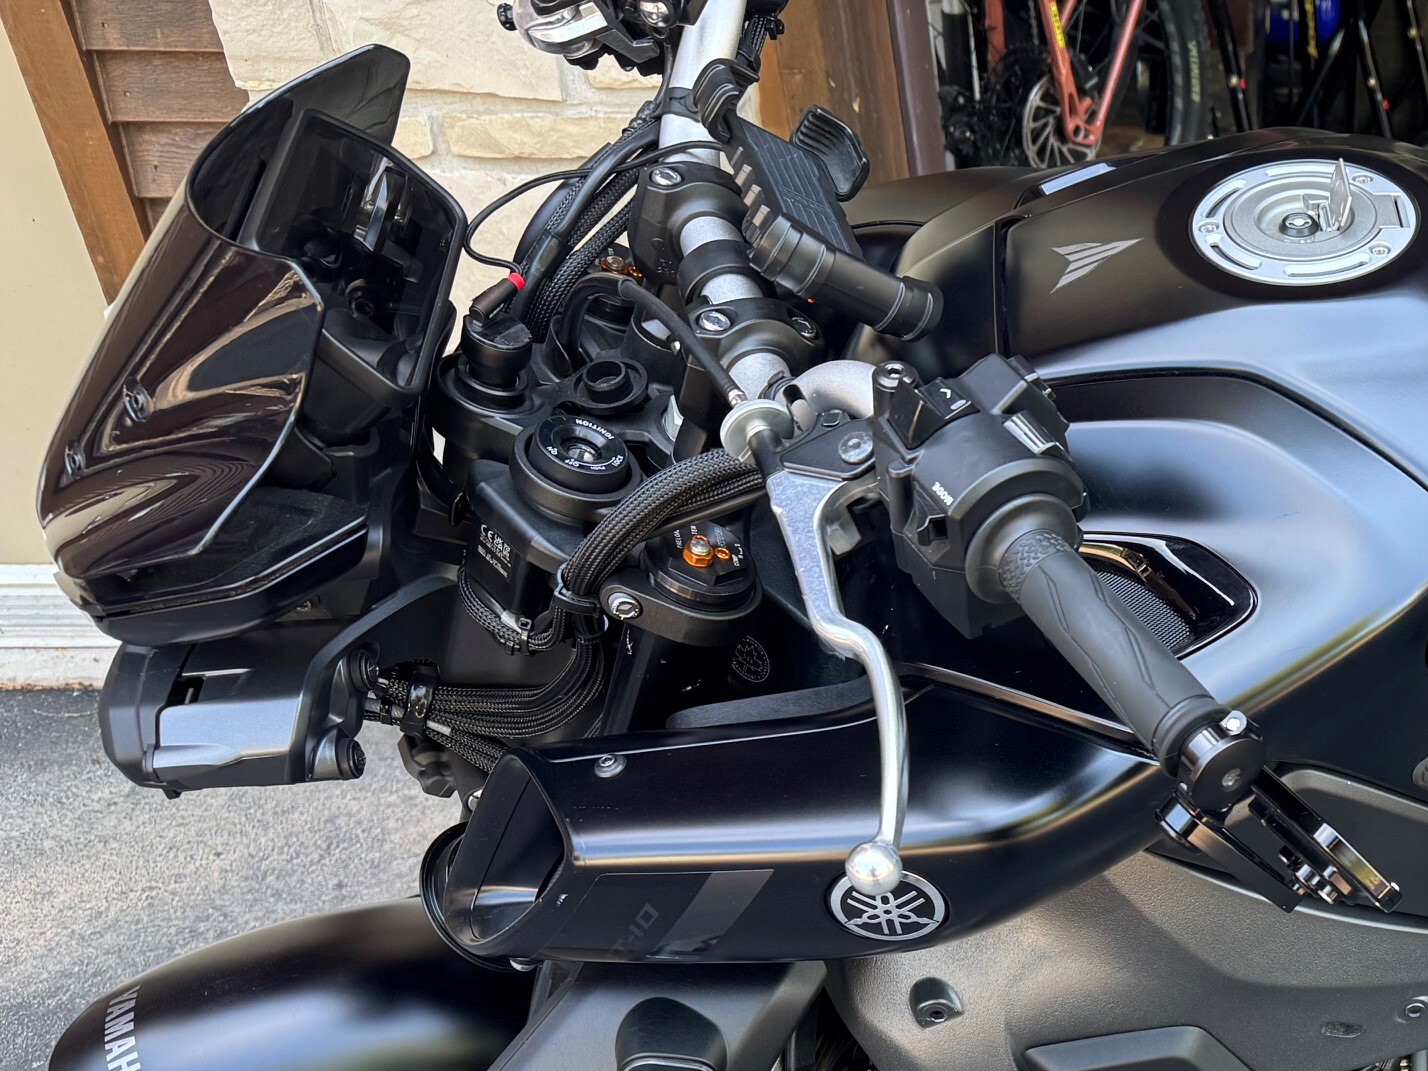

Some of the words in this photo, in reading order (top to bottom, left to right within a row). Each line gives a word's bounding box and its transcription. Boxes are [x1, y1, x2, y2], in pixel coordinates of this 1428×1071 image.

[575, 418, 615, 440] IGNITION
[546, 446, 558, 456] ON
[931, 481, 954, 506] MODE
